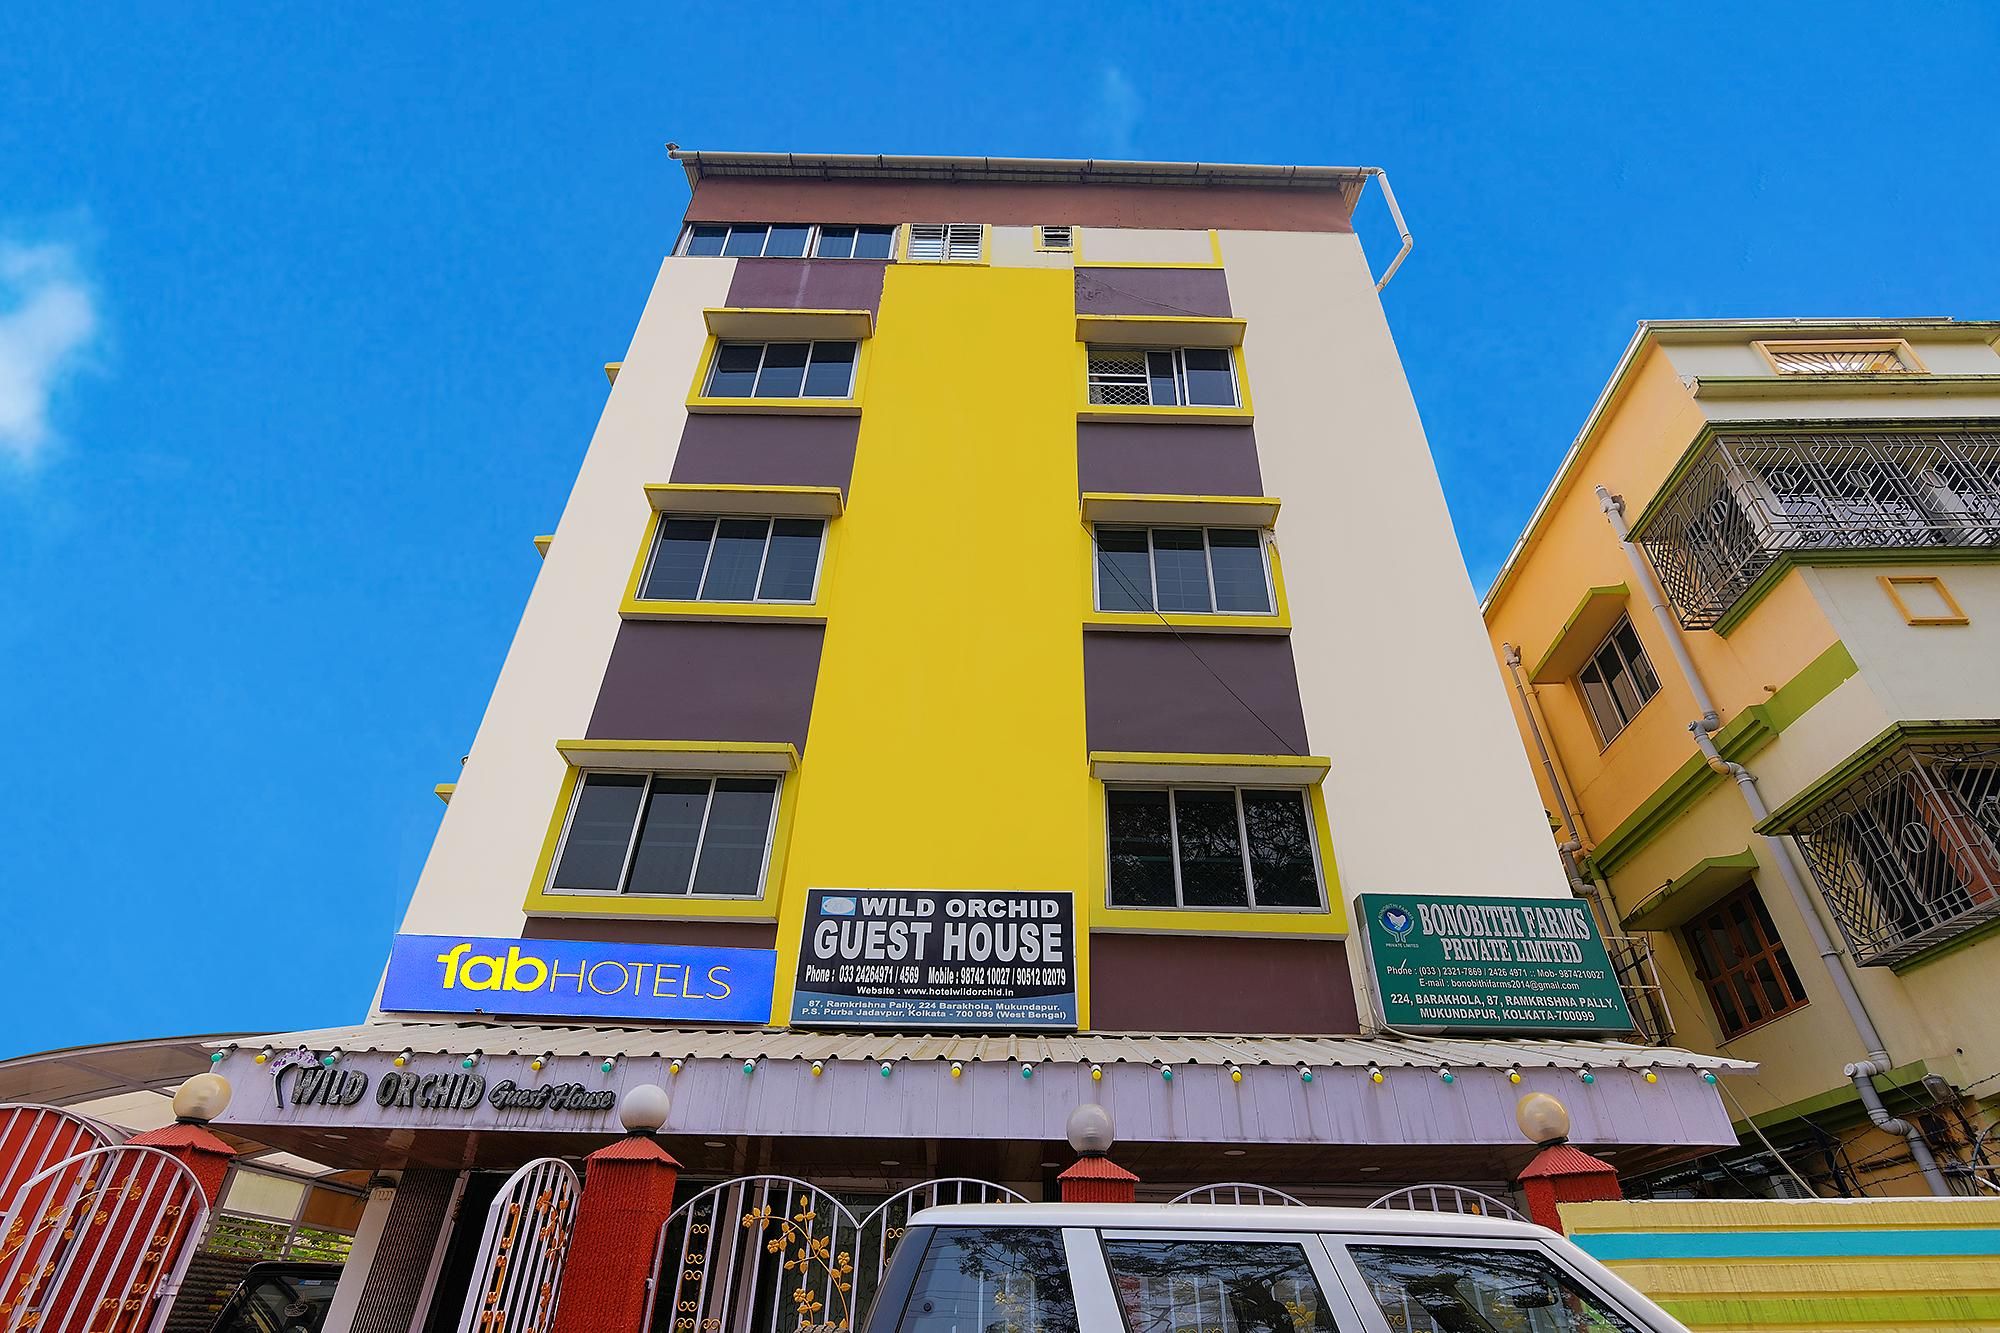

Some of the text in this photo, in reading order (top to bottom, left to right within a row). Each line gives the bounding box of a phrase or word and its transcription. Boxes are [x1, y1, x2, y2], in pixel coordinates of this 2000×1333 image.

[862, 897, 1059, 918] WILD ORCHID
[1416, 904, 1591, 940] BONOBITHI FARMS
[813, 920, 1063, 963] GUEST HOUSE
[1440, 939, 1583, 964] PRIVATE LIMITED
[839, 965, 854, 983] 033
[855, 965, 893, 983] 24264971
[900, 966, 919, 984] 4569
[961, 967, 984, 985] 98742
[987, 968, 1010, 985] 10027
[1017, 968, 1040, 986] 90512
[1042, 968, 1066, 986] 02079
[1387, 966, 1412, 975] Phone
[1443, 967, 1482, 976] 2321-7869
[1489, 968, 1507, 977] 2426
[1509, 969, 1528, 977] 4971
[1559, 970, 1605, 979] 9874210027
[857, 986, 894, 995] Website
[904, 987, 1014, 997] www.hotelwildorchid.in
[1419, 979, 1444, 987] E-mail
[1451, 979, 1580, 991] bonobithifarms2014@gmail.com
[809, 1000, 823, 1008] 87,
[889, 1001, 916, 1010] Pally,
[996, 1003, 1060, 1011] Mukundapur.
[1391, 994, 1414, 1006] 224,
[1415, 994, 1485, 1007] BARAKHOLA,
[1505, 996, 1578, 1008] RAMKRISHNA
[1580, 998, 1618, 1010] PALLY,
[824, 1008, 853, 1016] Purba
[856, 1009, 905, 1017] Jadavpur,
[996, 1011, 1025, 1019] (West
[1028, 1011, 1066, 1020] Bengal)
[1420, 1008, 1595, 1022] MUKUNDAPUR, KOLKATA-700099
[291, 1068, 616, 1111] WILD ORCHID Guest House
